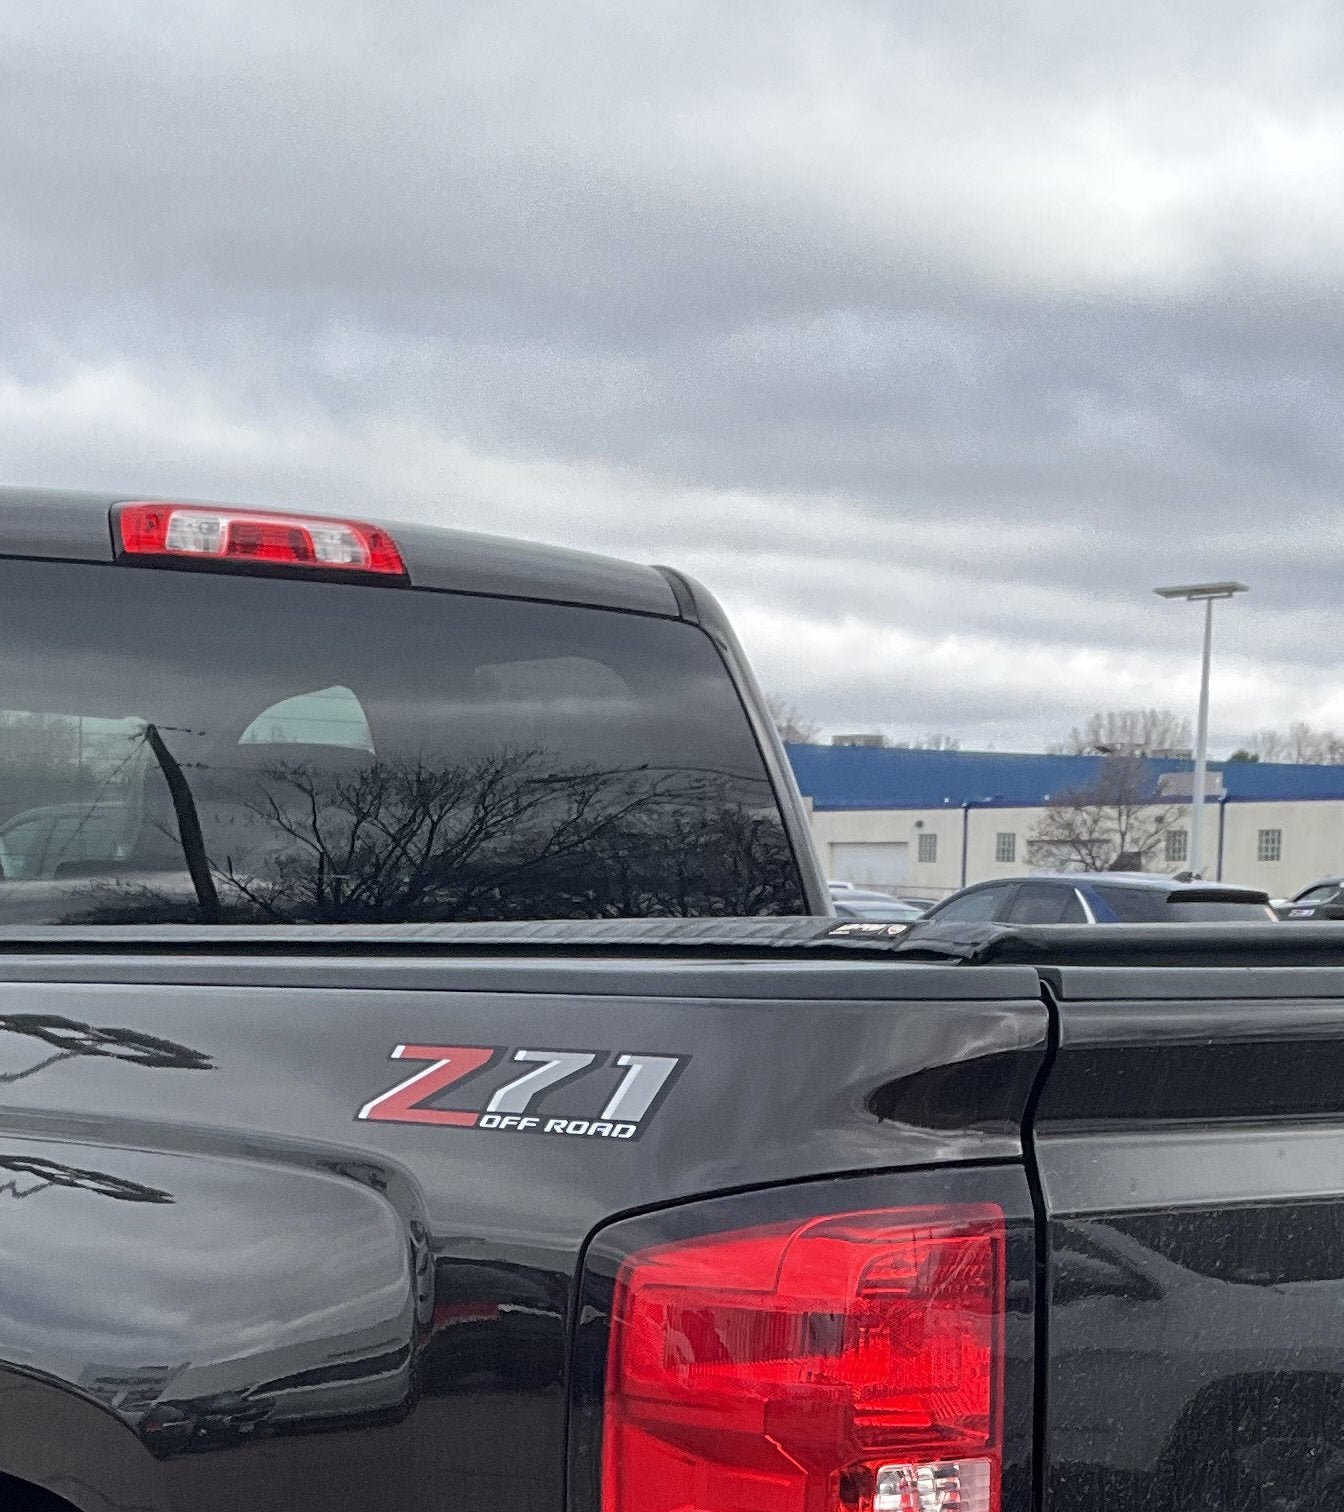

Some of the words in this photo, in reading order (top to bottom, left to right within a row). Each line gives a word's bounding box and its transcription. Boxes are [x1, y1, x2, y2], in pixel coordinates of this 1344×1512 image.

[356, 1043, 683, 1128] Z71
[479, 1113, 540, 1132] OFF
[543, 1118, 637, 1139] ROAD
